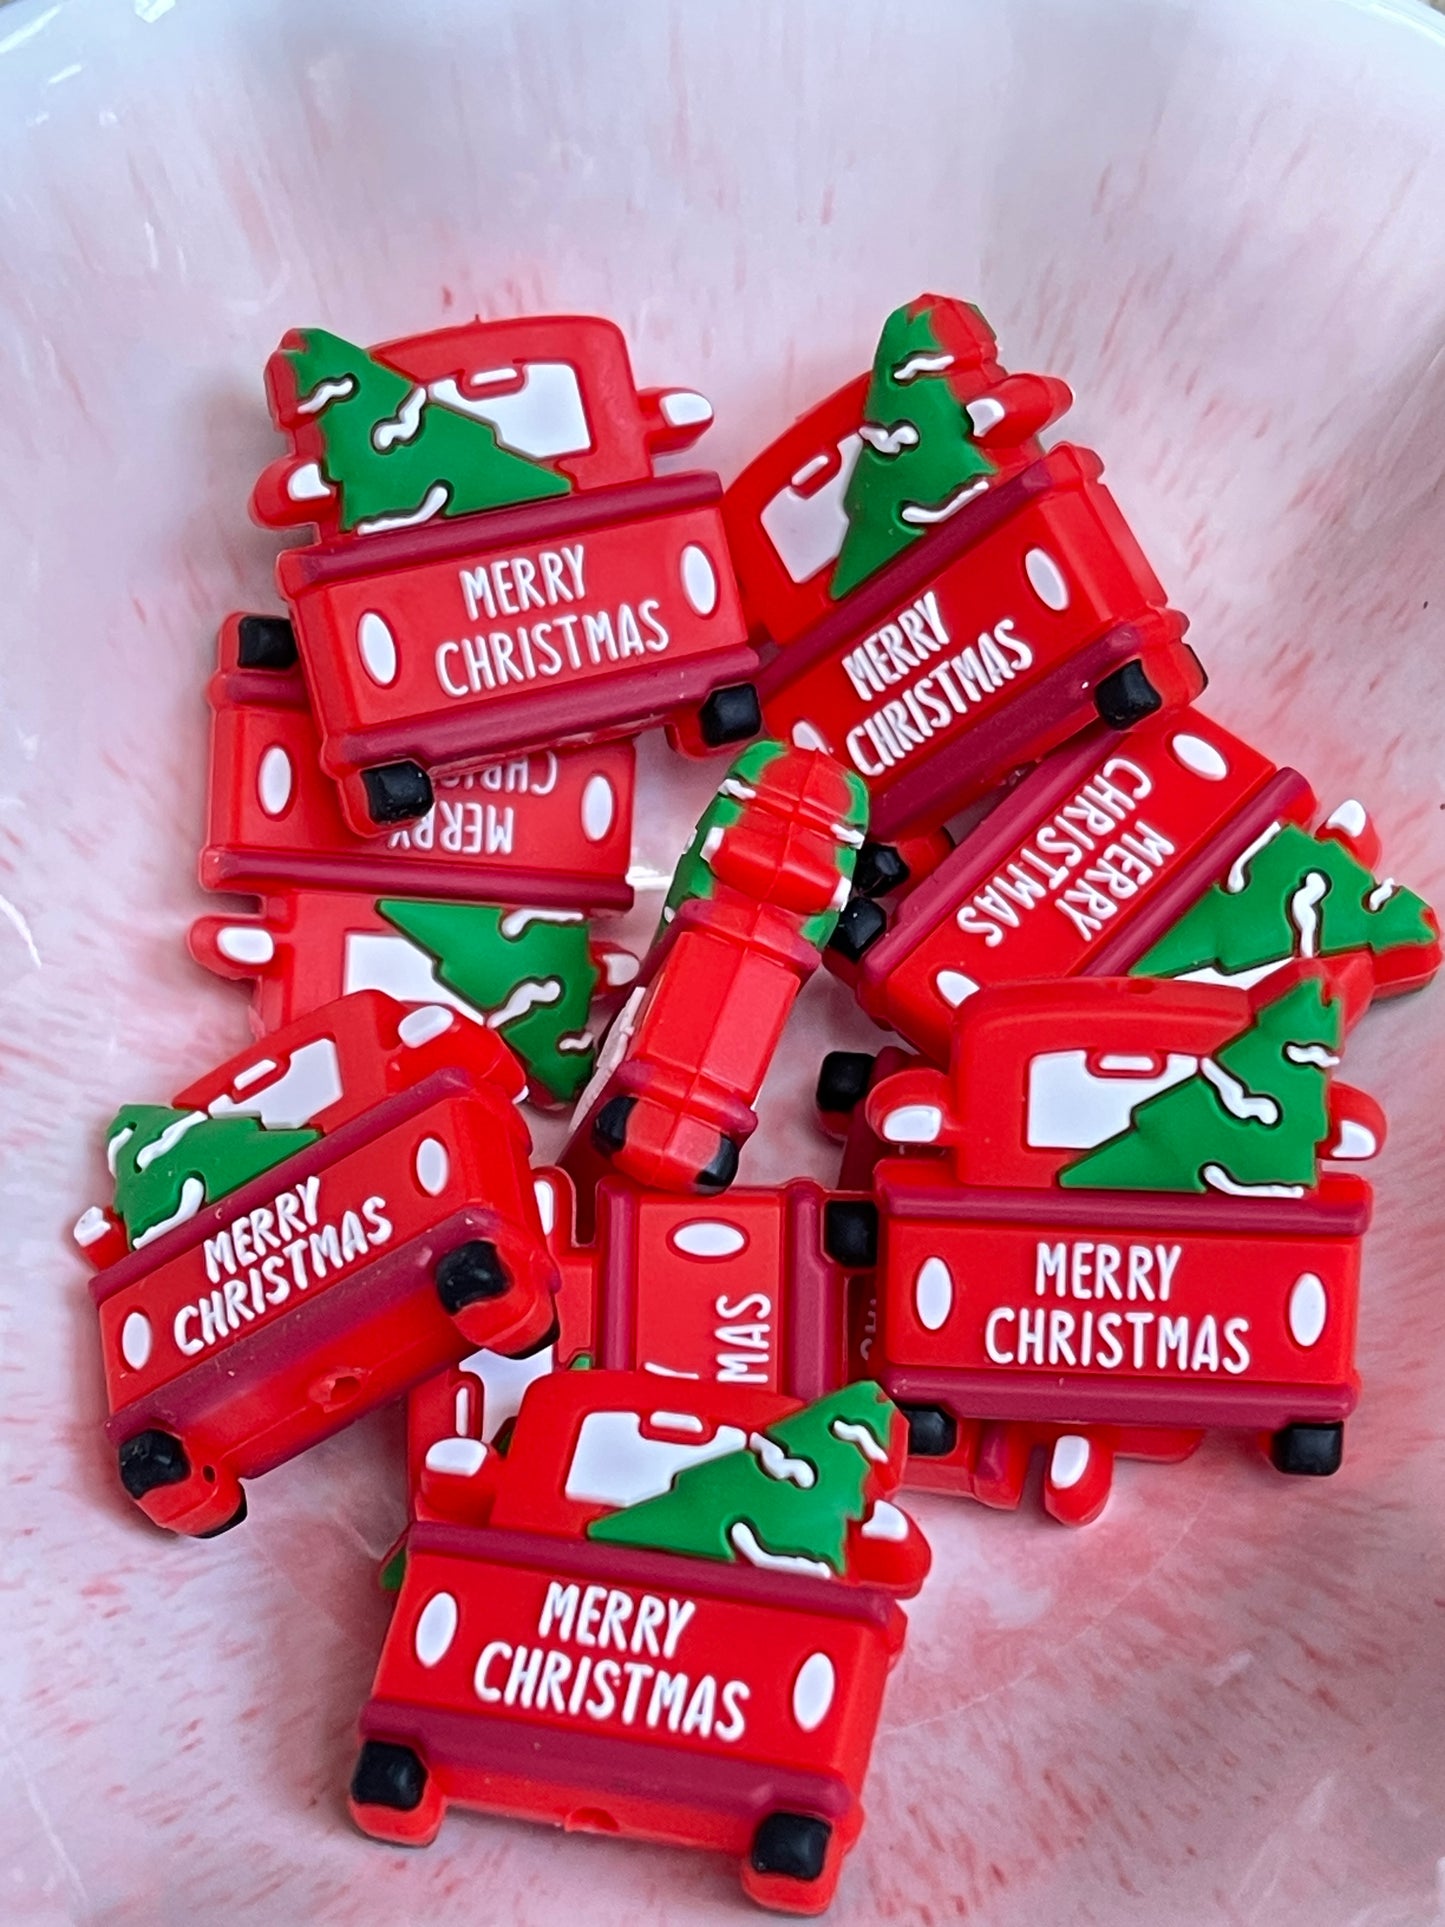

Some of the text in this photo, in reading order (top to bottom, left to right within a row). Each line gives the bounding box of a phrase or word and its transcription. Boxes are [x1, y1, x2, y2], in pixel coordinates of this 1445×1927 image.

[458, 542, 587, 622] MERRY
[434, 598, 671, 697] CHRISTMAS
[840, 589, 951, 702] MERRY
[845, 617, 1034, 777] CHRISTMAS
[955, 756, 1153, 948] CHRISTMAS
[1054, 819, 1176, 942] MERRY
[173, 1195, 394, 1357] CHRISTMAS
[202, 1174, 321, 1284] MERRY
[1034, 1241, 1183, 1303] MERRY
[984, 1305, 1251, 1375] CHRISTMAS
[537, 1580, 697, 1660] MERRY
[473, 1640, 751, 1742] CHRISTMAS
